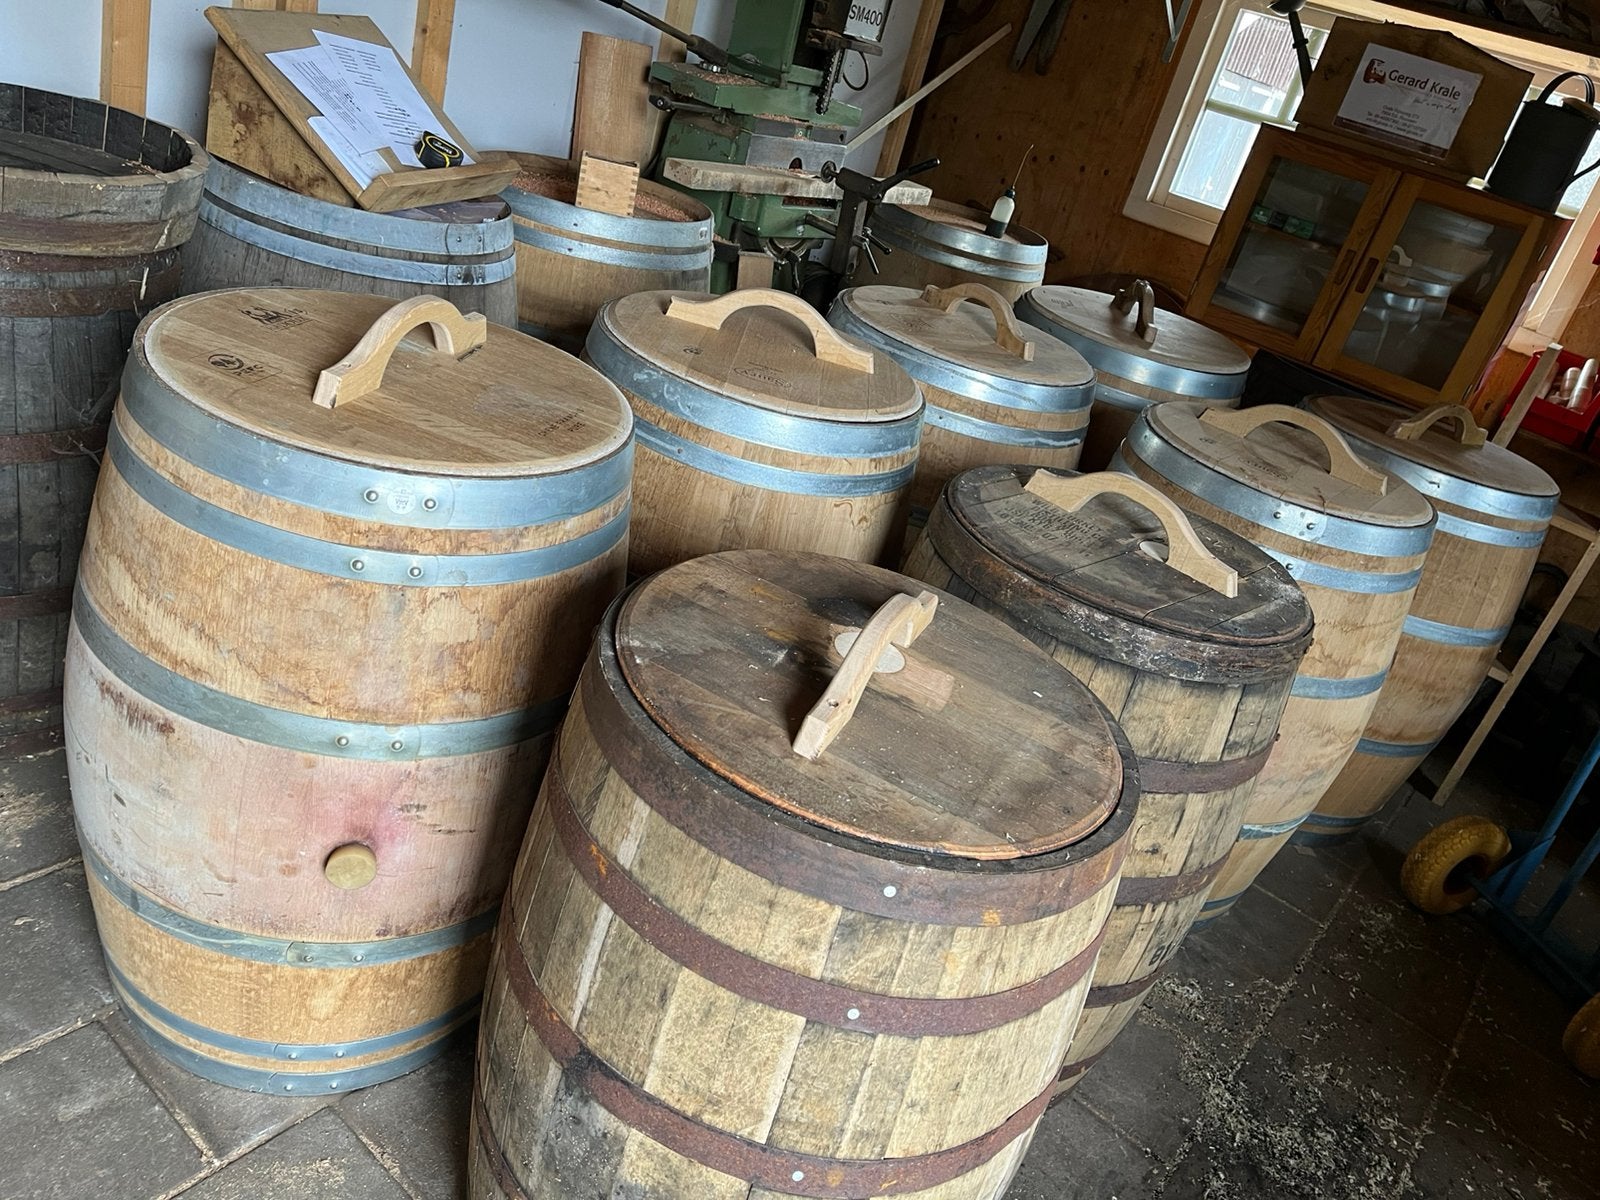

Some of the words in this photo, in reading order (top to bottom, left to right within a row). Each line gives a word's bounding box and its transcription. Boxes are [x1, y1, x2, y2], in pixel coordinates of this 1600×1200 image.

[848, 4, 883, 26] SM400
[1388, 69, 1429, 90] Gerard
[1430, 81, 1461, 100] Krale
